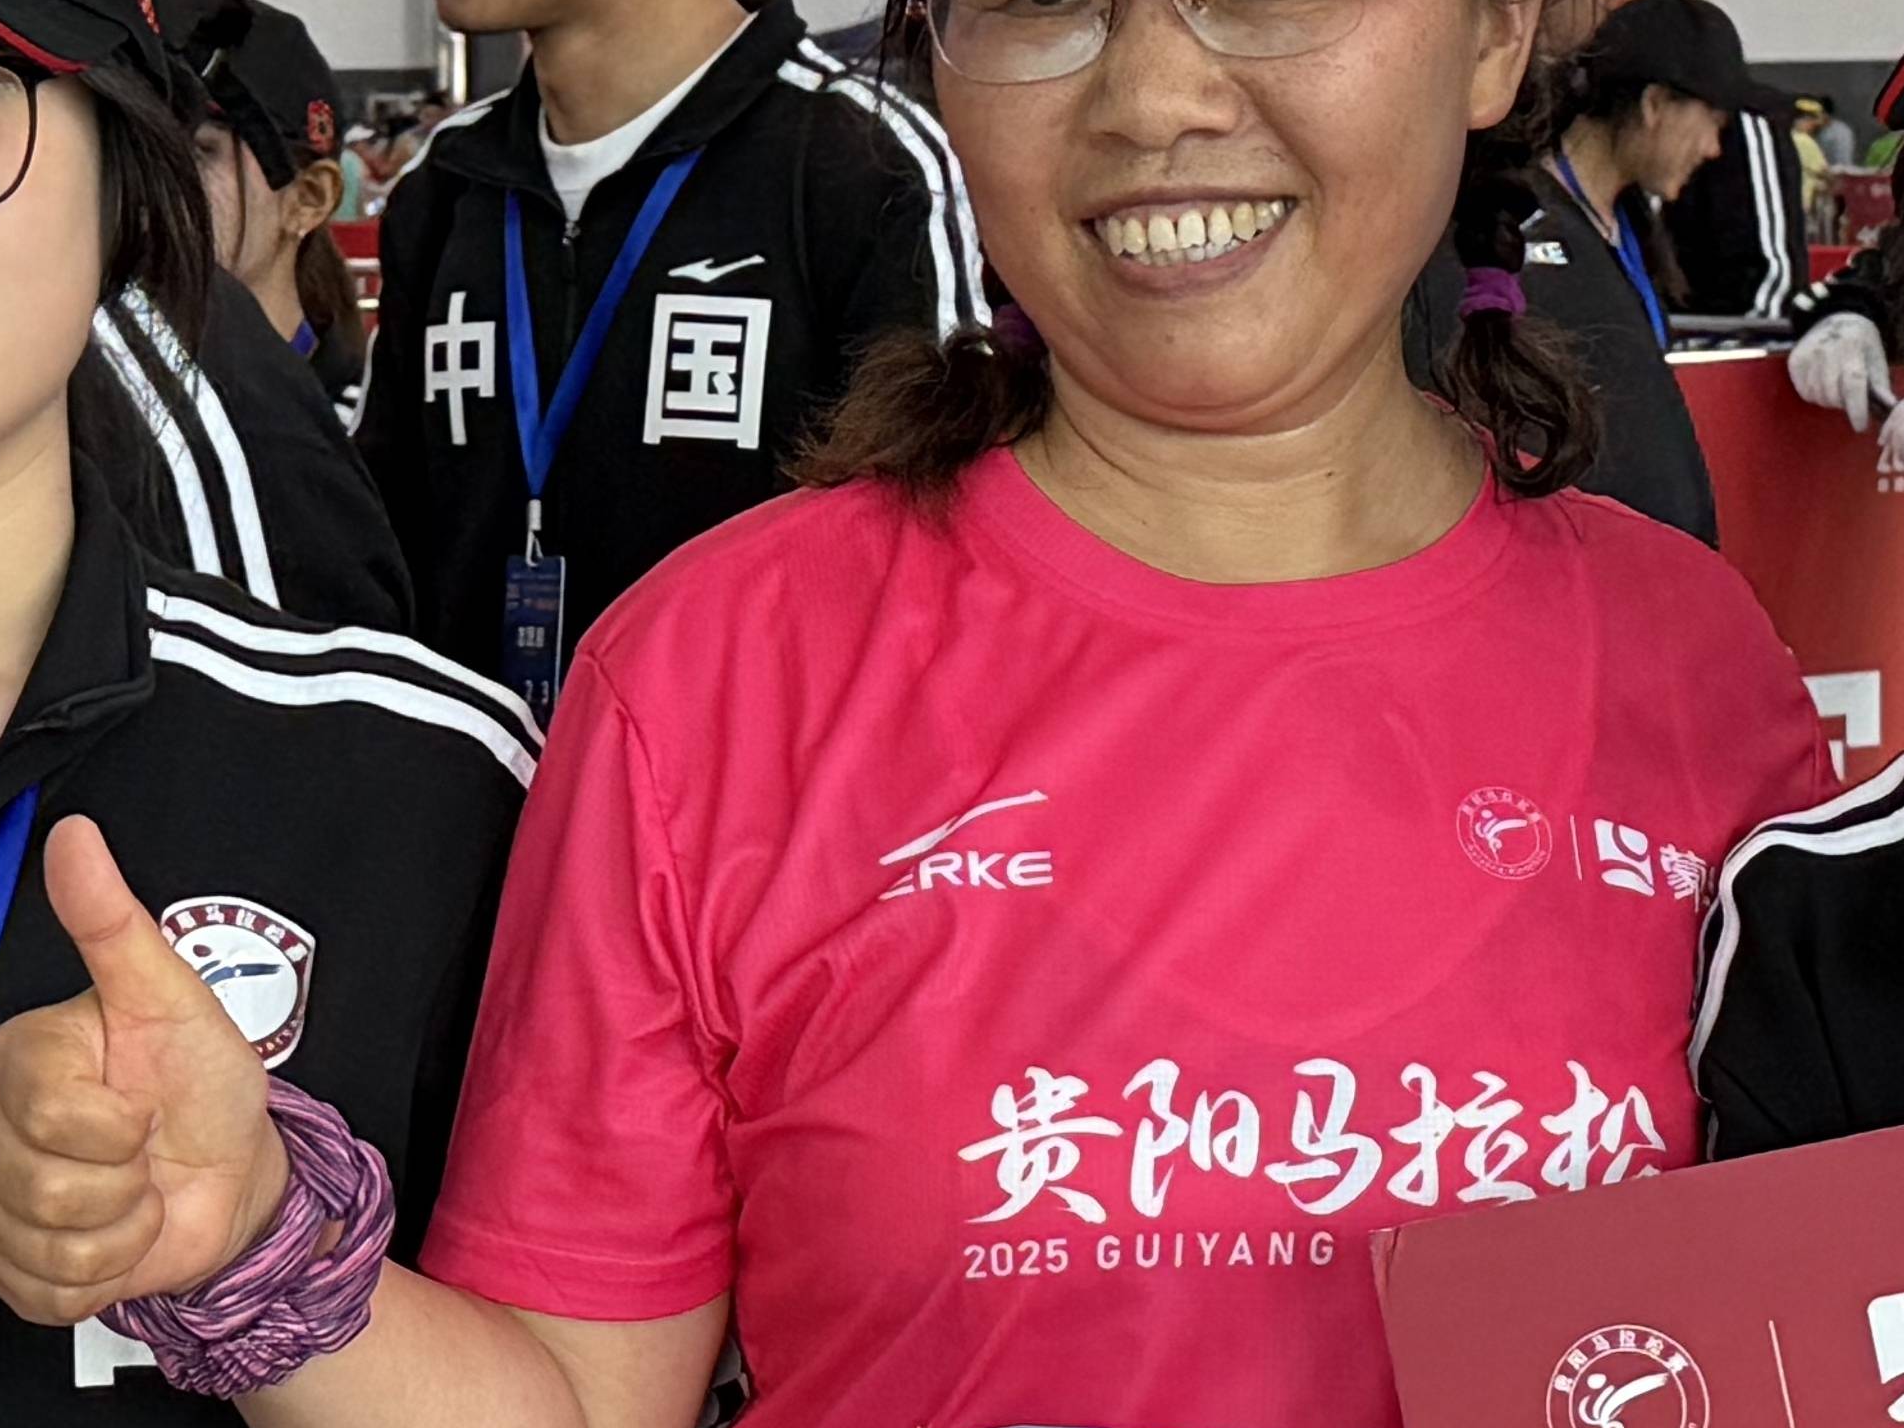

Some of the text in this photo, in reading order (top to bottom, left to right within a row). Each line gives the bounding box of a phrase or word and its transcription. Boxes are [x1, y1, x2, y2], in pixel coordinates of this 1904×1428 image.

[879, 850, 1054, 900] ERKE
[1660, 843, 1716, 913] 蒙
[957, 1058, 1667, 1224] 贵阳马拉松
[964, 1231, 1334, 1279] 2025 GUIYANG
